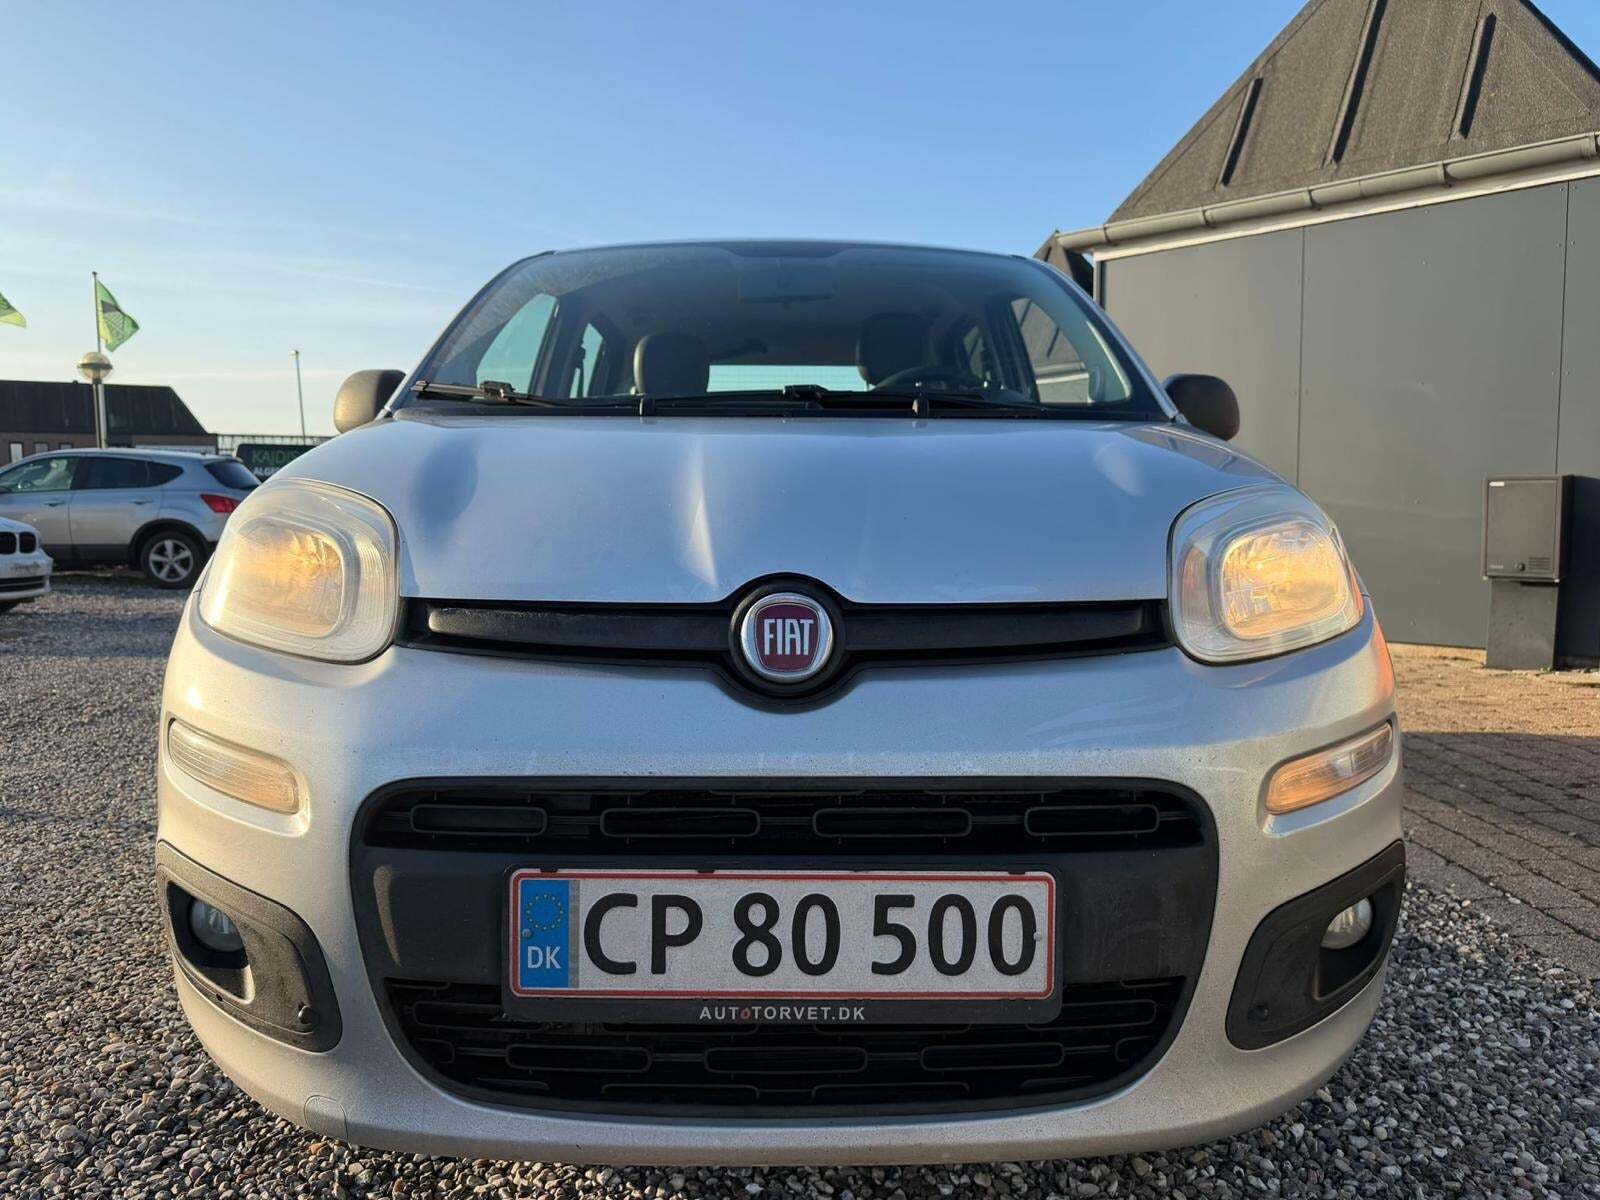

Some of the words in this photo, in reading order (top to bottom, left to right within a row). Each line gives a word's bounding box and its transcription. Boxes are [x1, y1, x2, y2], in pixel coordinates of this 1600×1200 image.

[763, 618, 814, 656] FIAT
[583, 892, 703, 975] CP
[732, 892, 841, 976] 80
[871, 893, 1037, 976] 500
[527, 945, 561, 969] DK
[699, 1006, 865, 1020] AUTOTORVET.DK
